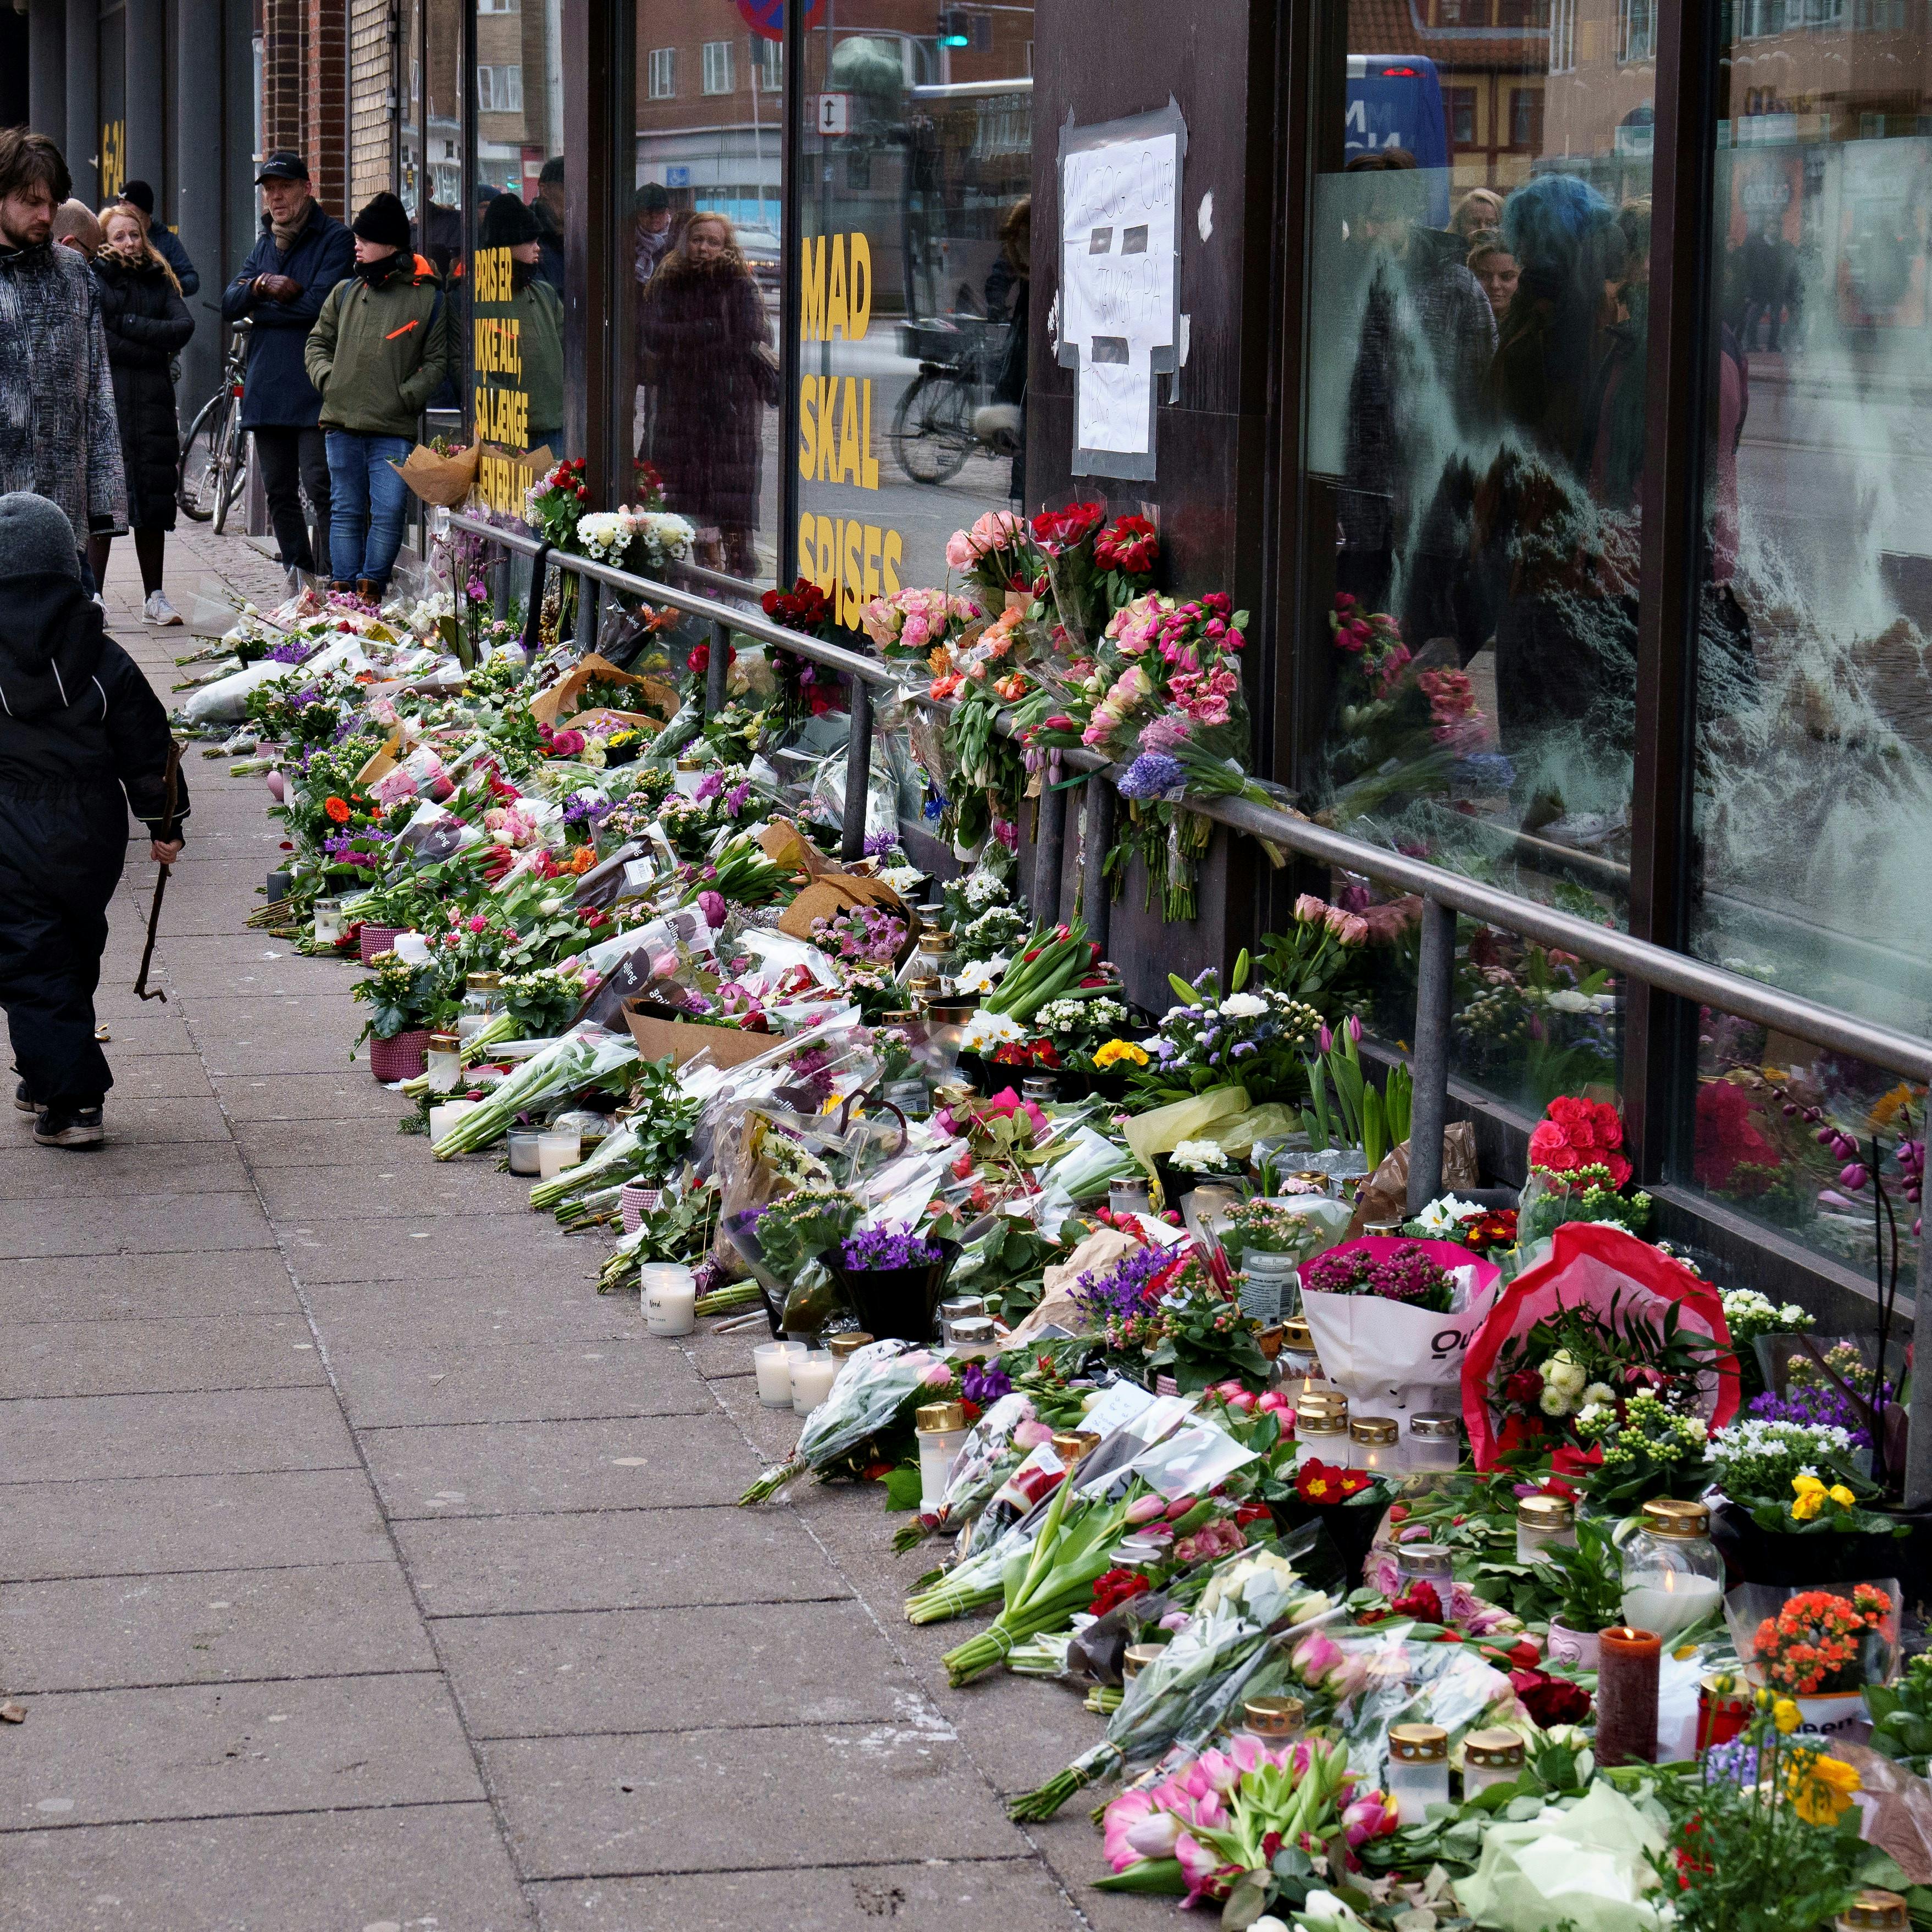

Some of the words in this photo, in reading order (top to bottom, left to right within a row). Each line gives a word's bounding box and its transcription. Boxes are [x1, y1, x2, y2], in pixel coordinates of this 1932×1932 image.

[475, 247, 497, 302] PRIS
[499, 246, 512, 301] ER
[801, 232, 871, 341] MAD
[475, 319, 498, 372] IKKE
[499, 318, 522, 385] ALT,
[490, 389, 528, 448] LÆNGE
[799, 374, 879, 490] SKAL
[799, 512, 902, 635] SPISES
[649, 1299, 662, 1308] Nord
